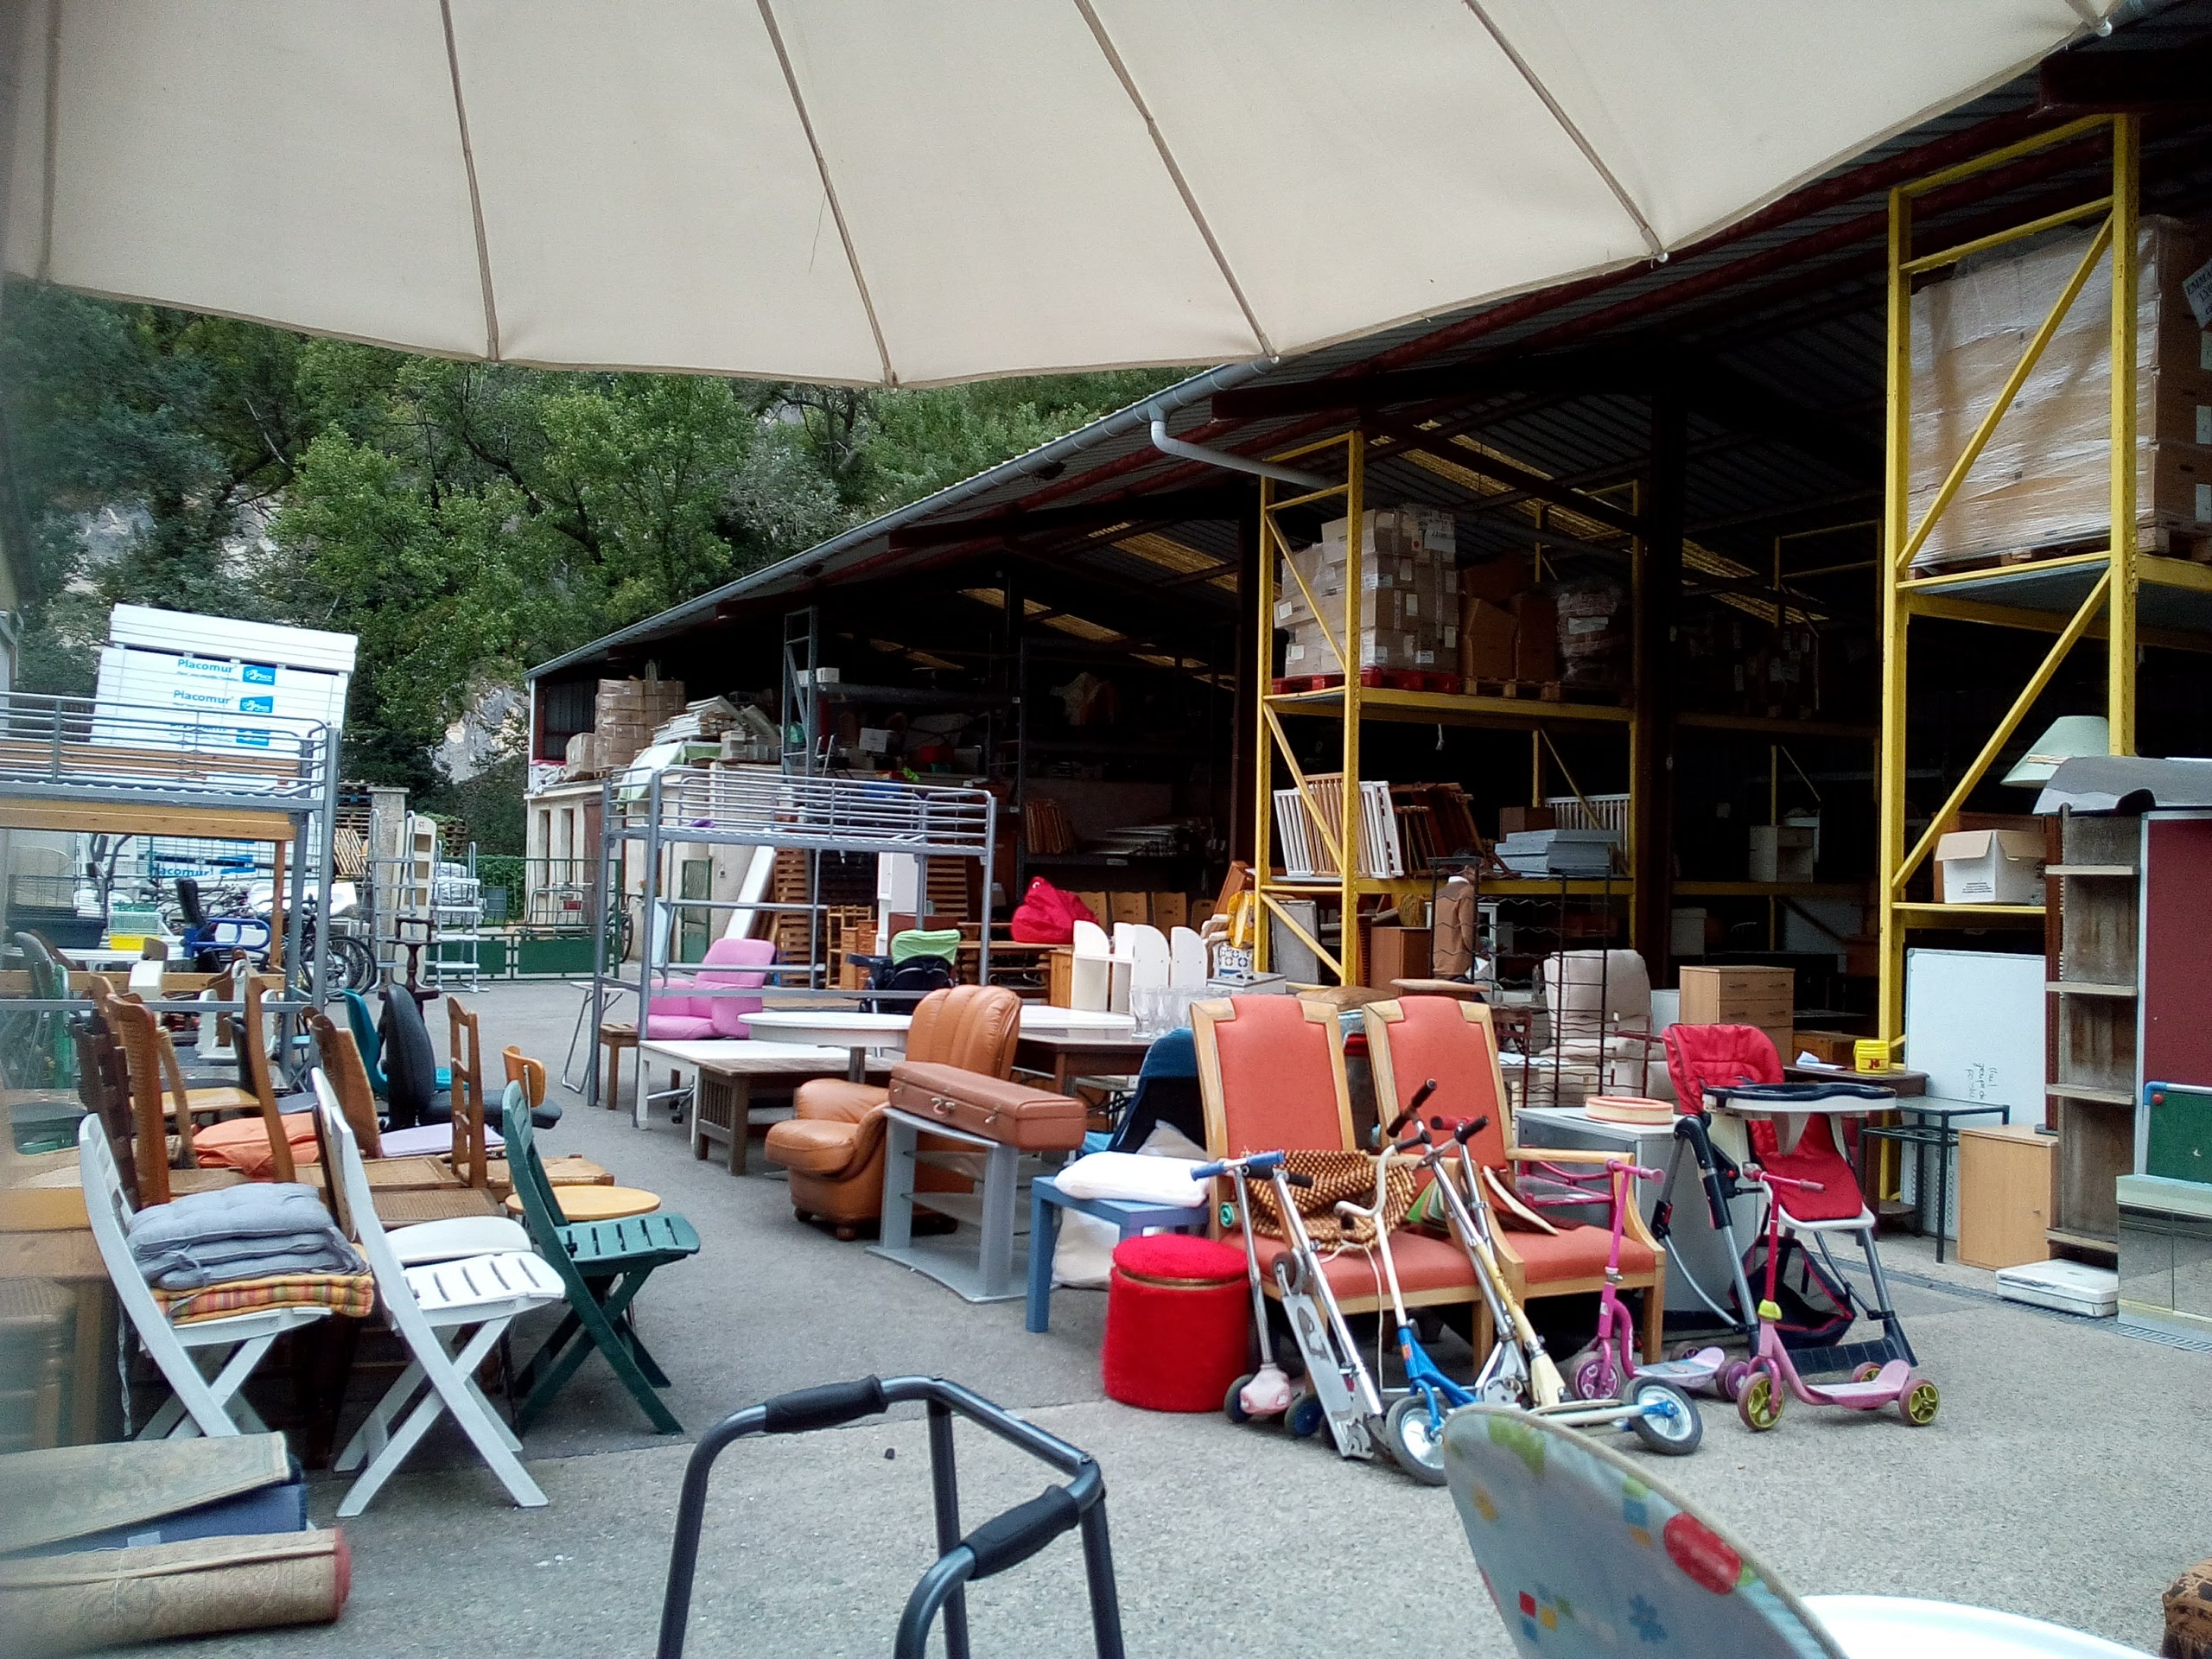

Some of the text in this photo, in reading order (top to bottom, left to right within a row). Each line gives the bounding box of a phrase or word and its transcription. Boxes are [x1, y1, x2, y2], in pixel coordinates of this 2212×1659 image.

[178, 658, 232, 673] Placomur
[174, 690, 231, 704] Placomur
[149, 865, 209, 877] acomur
